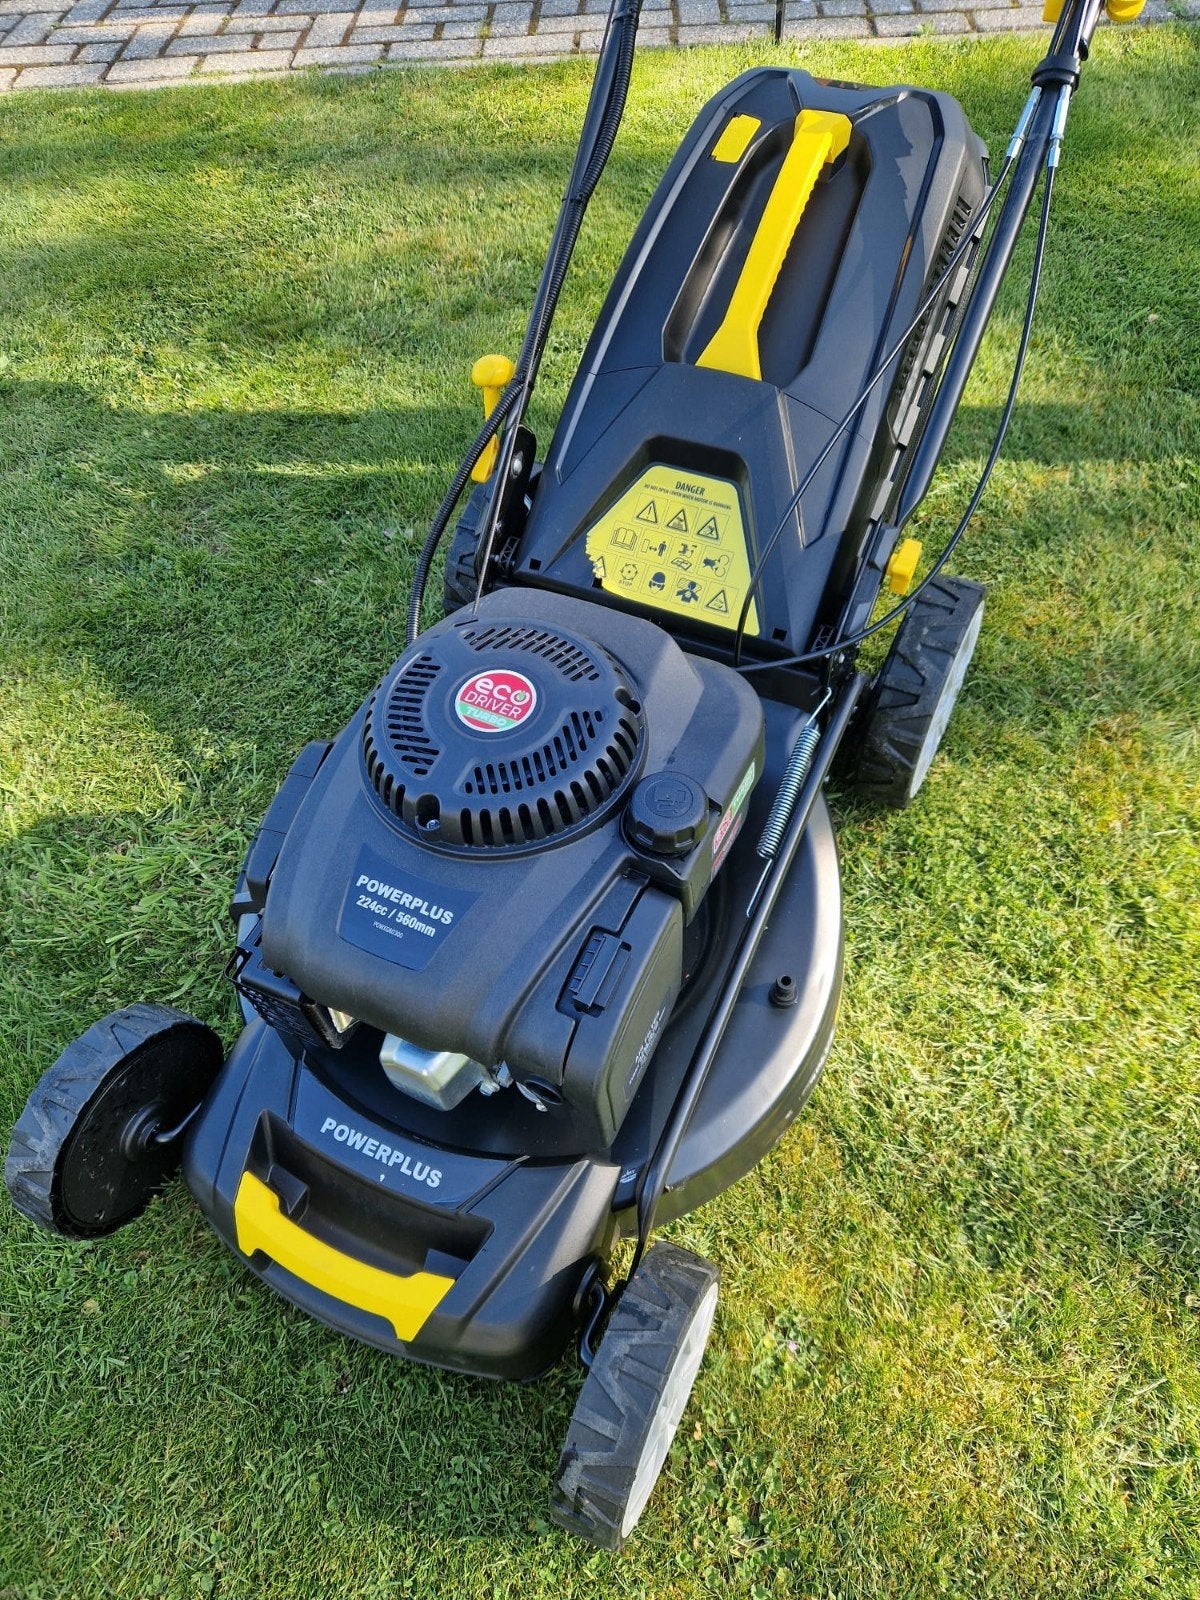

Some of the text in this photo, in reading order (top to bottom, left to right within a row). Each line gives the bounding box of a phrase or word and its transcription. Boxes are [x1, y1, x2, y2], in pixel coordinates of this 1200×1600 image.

[675, 481, 706, 496] DANGER
[618, 579, 633, 588] STOP
[464, 690, 522, 719] DRIVER
[475, 678, 531, 706] eco
[466, 706, 507, 727] TURBO
[356, 874, 454, 925] POWERPLUS
[356, 894, 436, 938] 224cc / 560mm
[320, 1117, 443, 1188] POWERPLUS
